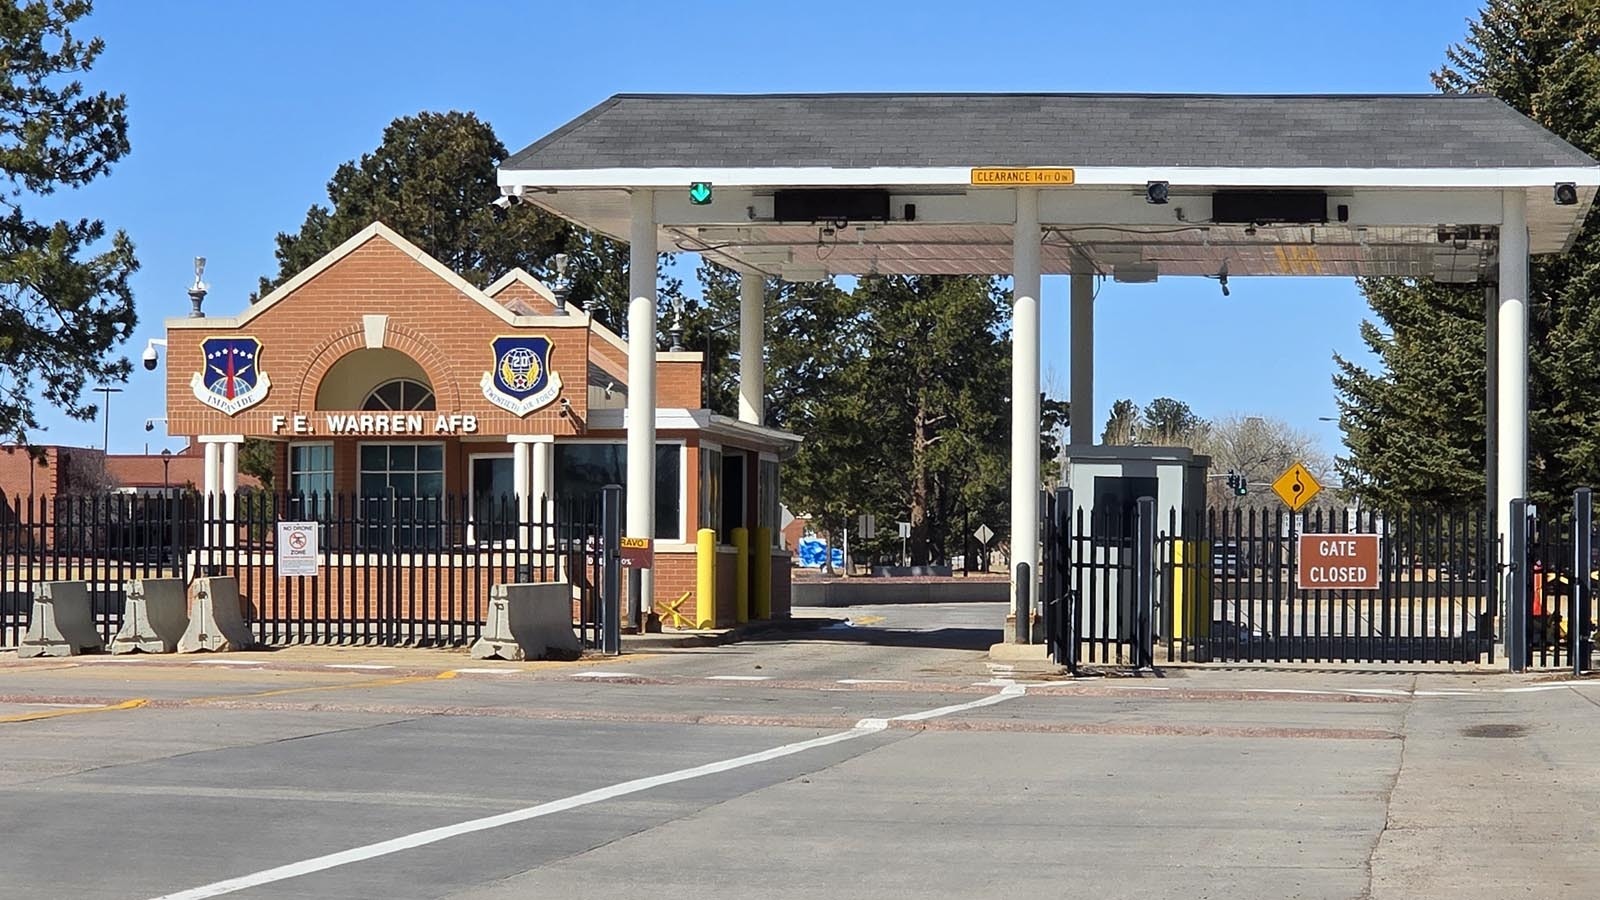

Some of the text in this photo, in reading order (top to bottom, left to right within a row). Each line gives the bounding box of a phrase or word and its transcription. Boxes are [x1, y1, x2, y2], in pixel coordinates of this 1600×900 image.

[977, 171, 1030, 182] CLEARANCE
[513, 355, 528, 368] 20
[327, 415, 422, 432] WARREN
[435, 415, 477, 432] AFB
[620, 539, 644, 547] RAVO
[1319, 540, 1357, 556] GATE
[1310, 566, 1367, 582] CLOSED
